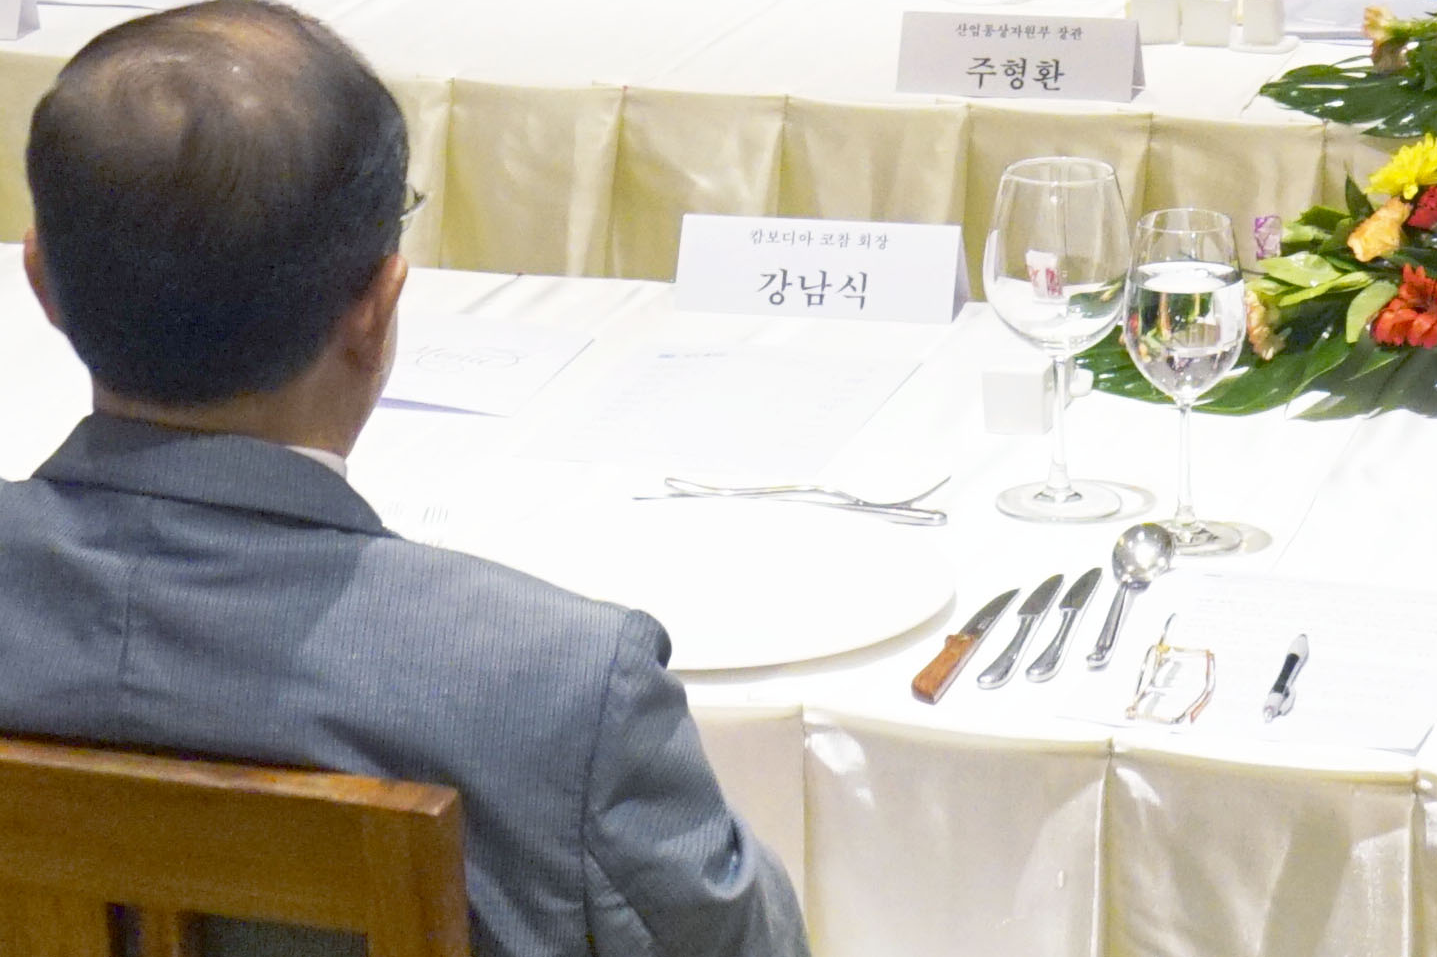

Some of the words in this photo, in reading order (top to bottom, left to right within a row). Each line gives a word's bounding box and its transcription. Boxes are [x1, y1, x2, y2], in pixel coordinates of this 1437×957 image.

[956, 23, 1050, 40] 산업통상자원부
[1058, 25, 1084, 41] 장관
[966, 57, 1065, 91] 주형환
[750, 228, 814, 247] 캄보디아
[857, 233, 888, 250] 회장
[757, 268, 867, 310] 강남식
